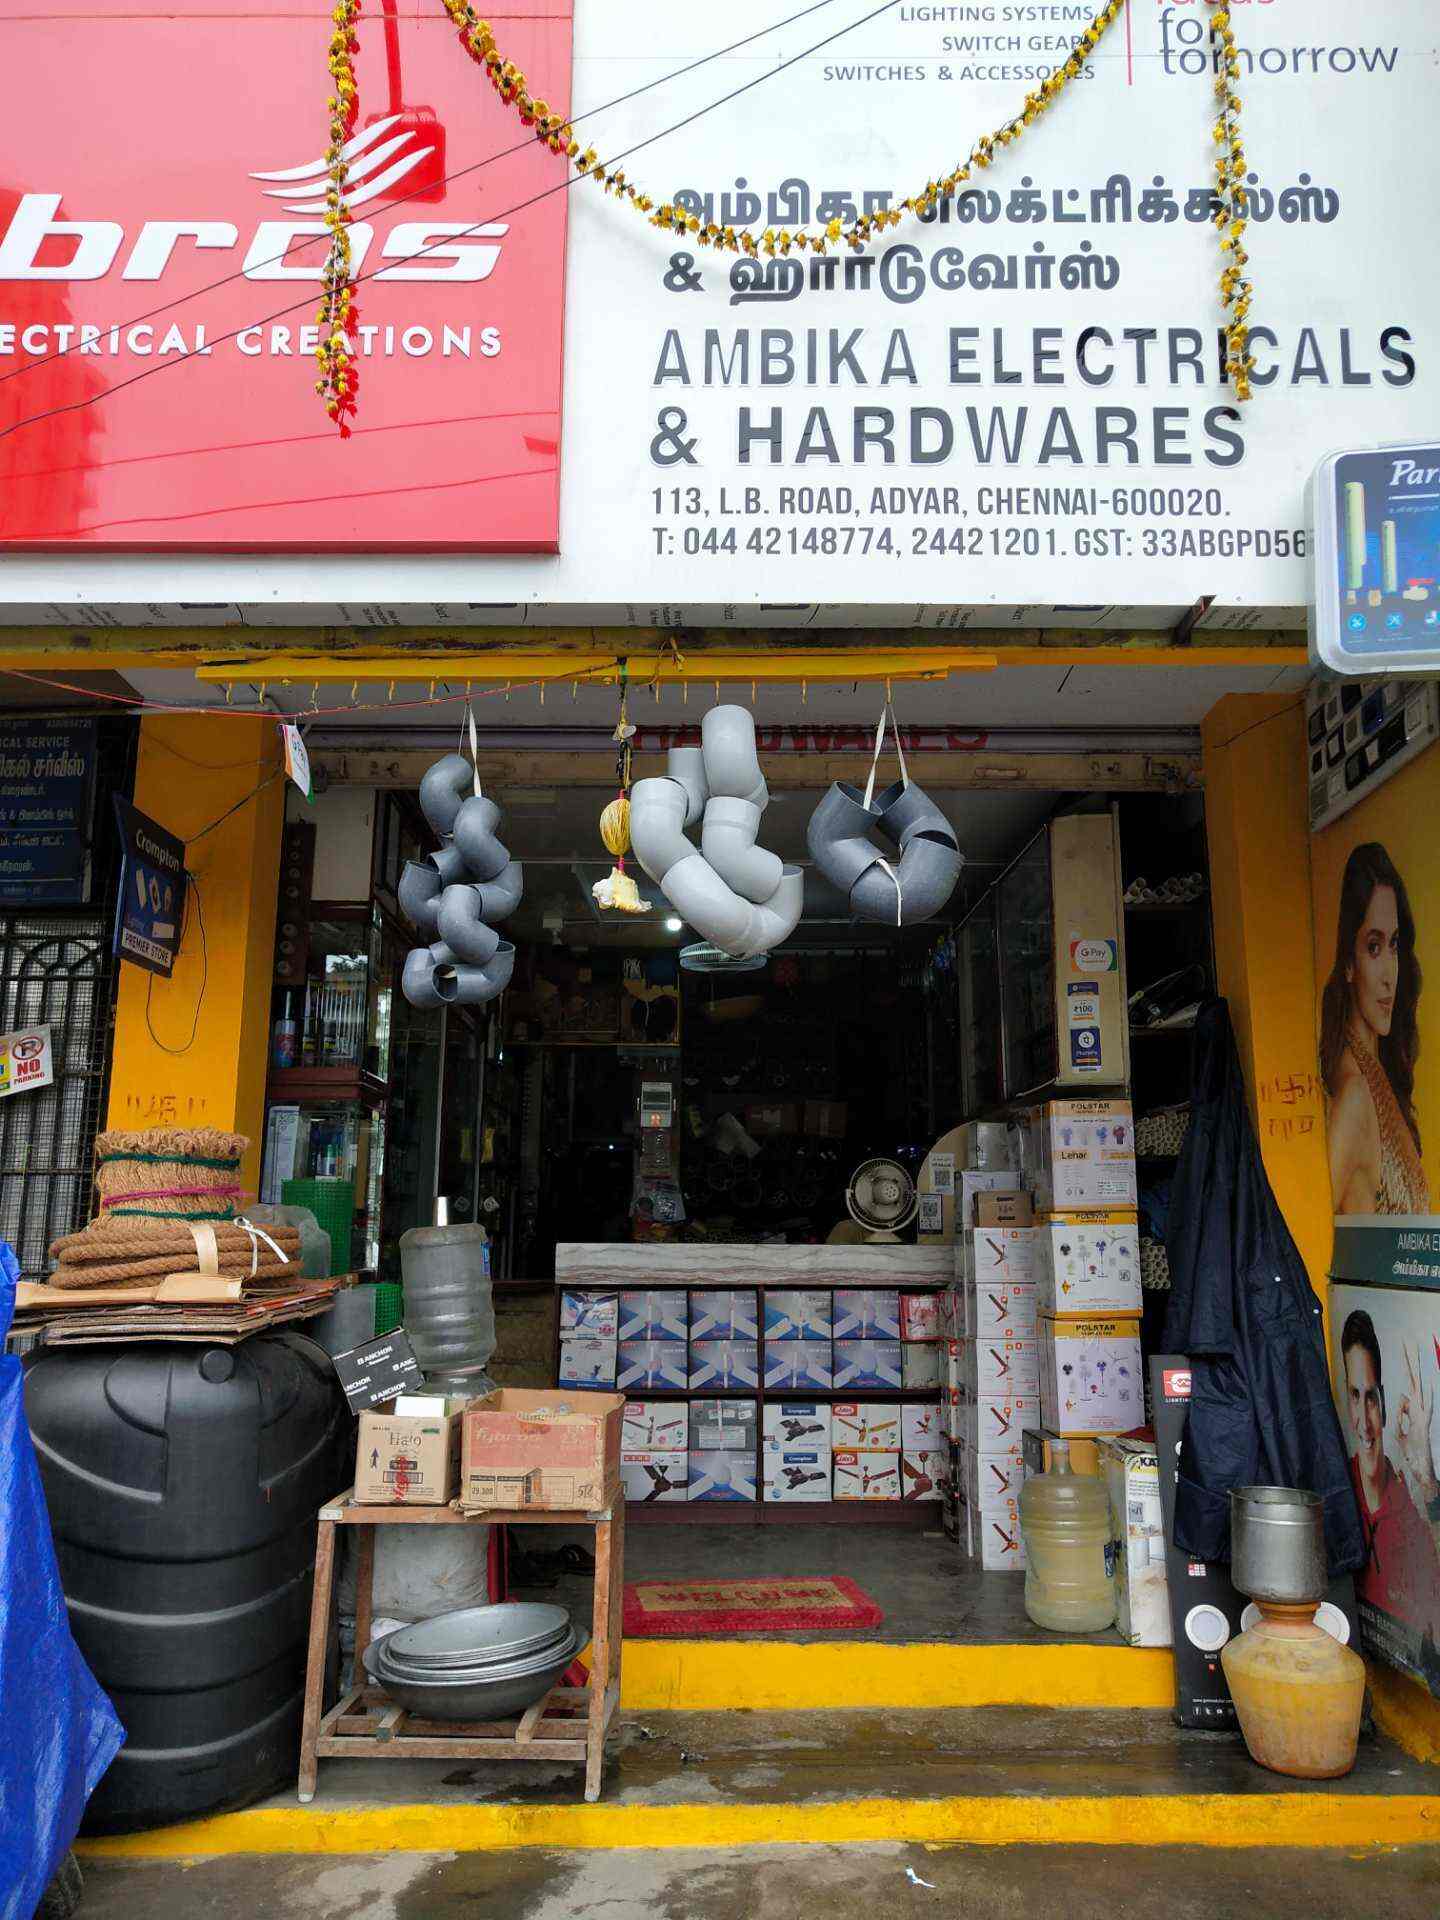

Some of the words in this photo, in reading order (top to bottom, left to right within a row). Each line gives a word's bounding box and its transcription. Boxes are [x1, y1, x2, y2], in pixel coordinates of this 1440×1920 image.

[899, 6, 995, 22] LIGHTING
[1002, 5, 1094, 21] SYSTEMS
[942, 35, 1021, 51] SWITCH
[1028, 35, 1086, 51] GEAR
[1159, 44, 1399, 75] tomorrow
[823, 65, 926, 81] SWITCHES
[938, 65, 953, 81] &
[960, 65, 1095, 81] ACCESSOS
[663, 251, 706, 293] &
[729, 240, 1120, 306] ஹார்டுவேர்ஸ்
[653, 327, 919, 385] AMBIKA
[949, 325, 1417, 387] ELECTRICALS
[650, 405, 699, 466] &
[738, 405, 1246, 467] HARDWARES
[1389, 460, 1440, 486] Par
[652, 487, 710, 517] 113,
[719, 487, 769, 514] L.B.
[779, 487, 860, 517] ROAD,
[870, 487, 968, 517] ADYAR,
[977, 487, 1230, 516] CHENNAI-600020.
[652, 527, 674, 556] T:
[683, 527, 737, 555] 044
[746, 527, 901, 558] 42148774,
[1074, 528, 1133, 557] GST:
[26, 735, 71, 748] SERVICE
[135, 828, 180, 873] Crompton
[125, 932, 150, 957] PREMIER
[17, 1059, 41, 1075] NO
[1397, 1233, 1431, 1250] AMBIKA
[364, 1345, 393, 1363] ANCHOR
[377, 1381, 407, 1399] ANCHOR
